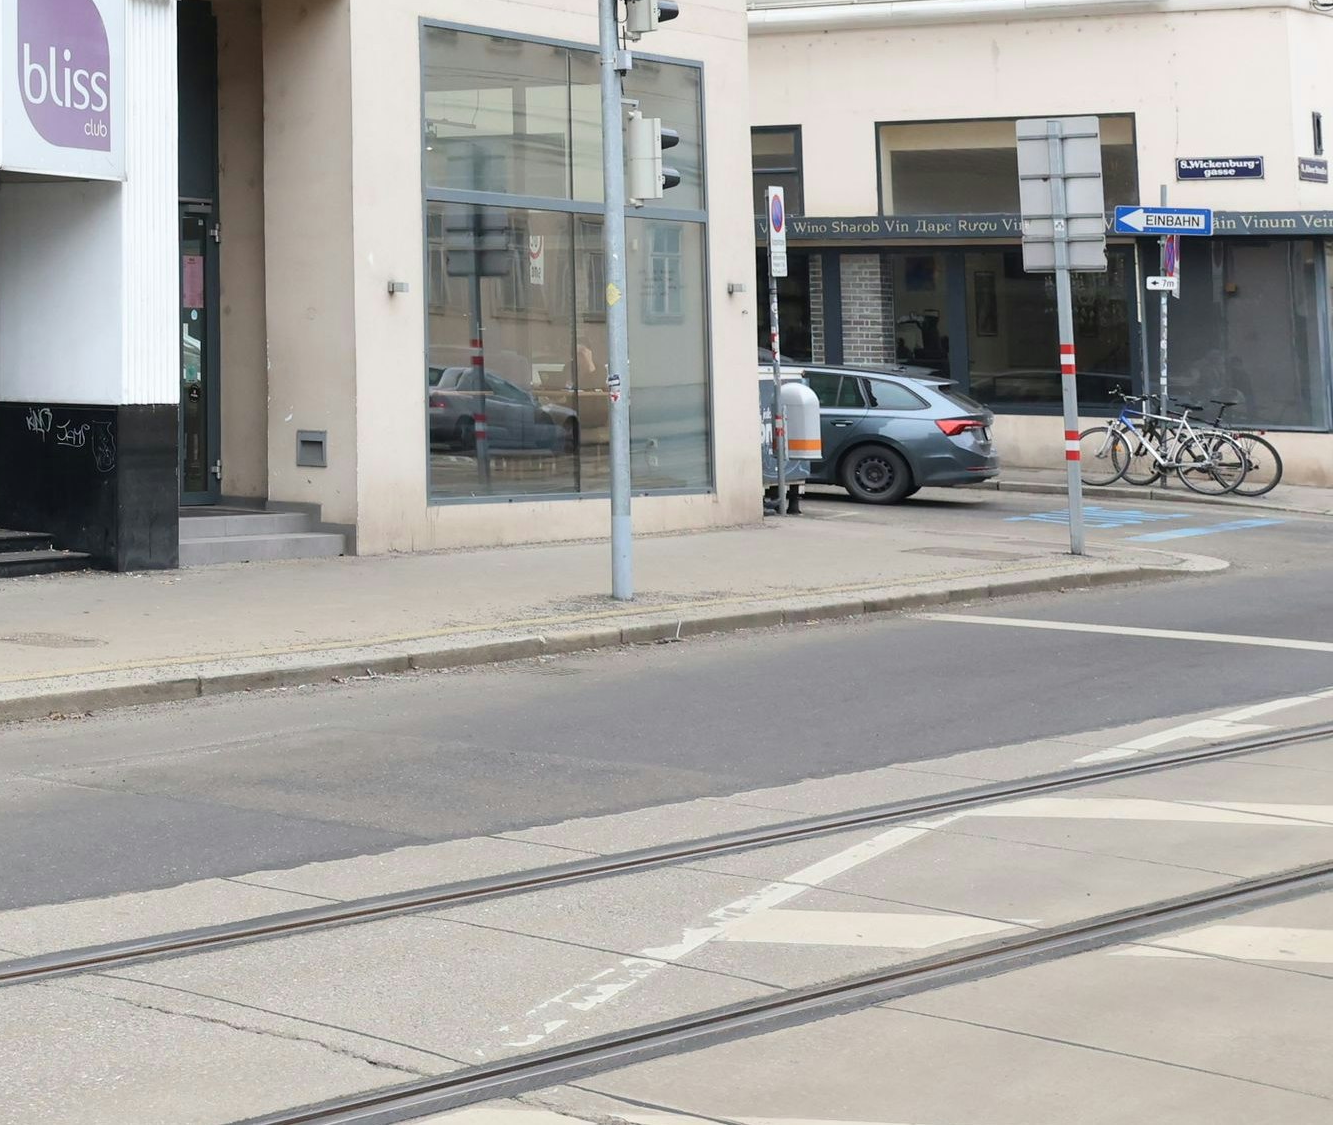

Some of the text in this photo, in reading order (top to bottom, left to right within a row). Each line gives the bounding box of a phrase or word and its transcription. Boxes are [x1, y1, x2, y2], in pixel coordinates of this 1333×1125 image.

[23, 44, 108, 113] bliss
[83, 118, 108, 137] club
[1203, 168, 1236, 177] gasse
[793, 221, 827, 234] Wino
[831, 220, 880, 234] Sharob
[884, 220, 909, 233] Vin
[1145, 214, 1200, 227] EINBAHN
[1213, 215, 1236, 229] äin
[1240, 214, 1296, 228] Vinum
